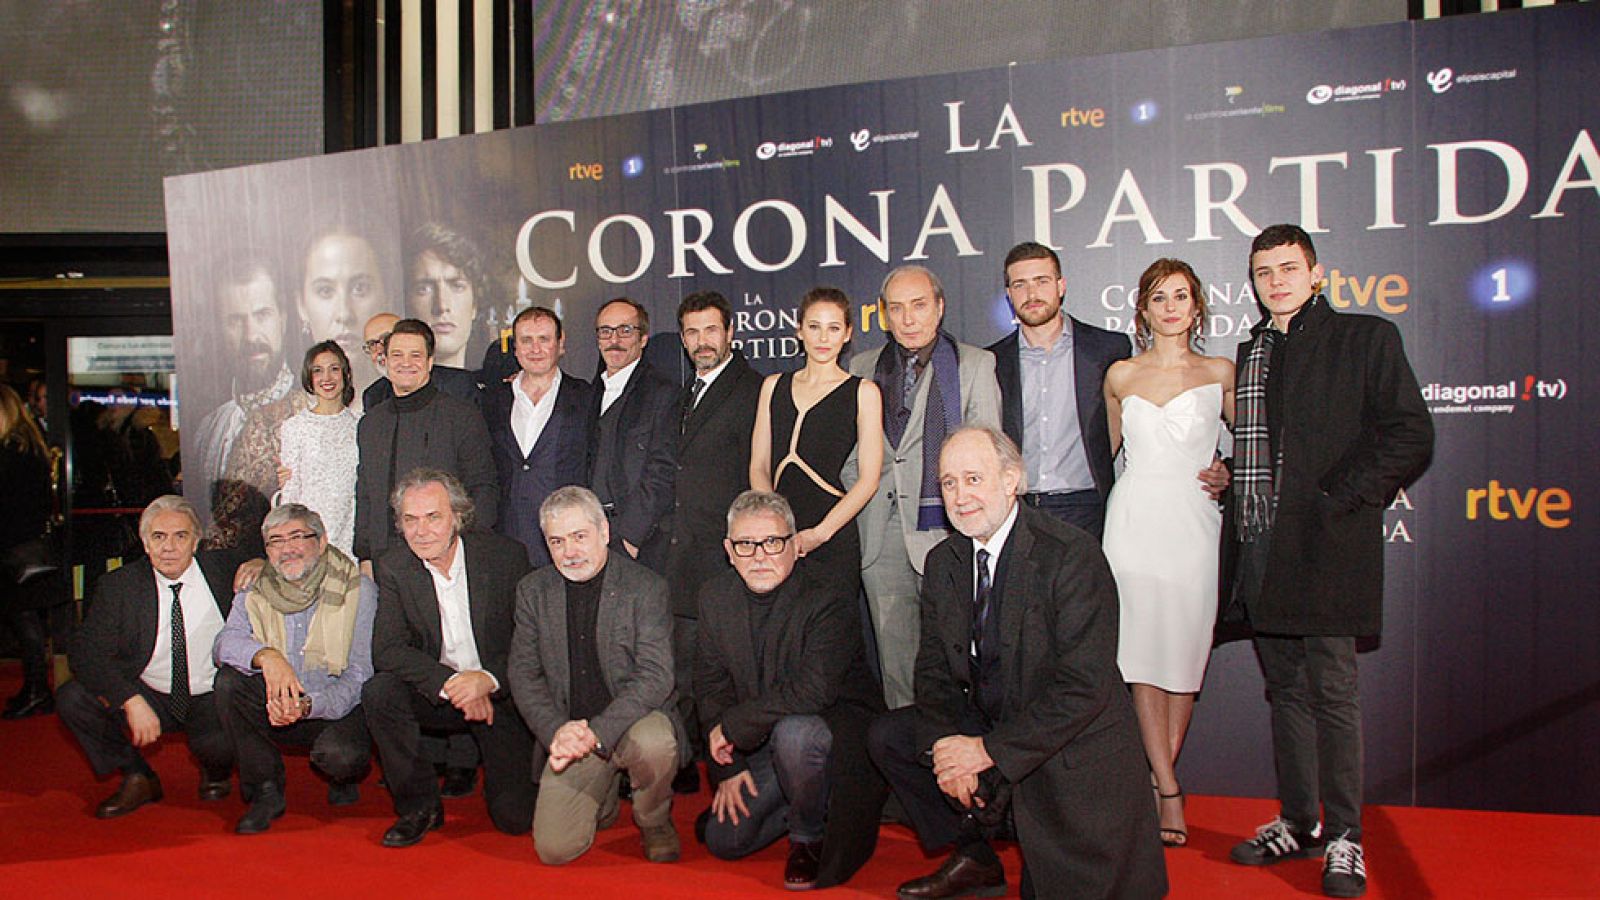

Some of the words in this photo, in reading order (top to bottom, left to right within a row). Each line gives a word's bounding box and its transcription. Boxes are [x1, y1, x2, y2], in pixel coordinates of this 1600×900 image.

[1333, 82, 1381, 96] diagonal
[943, 101, 1035, 154] LA
[1060, 107, 1105, 128] rtve
[569, 162, 604, 180] rtve
[515, 183, 984, 290] CORONA
[1022, 128, 1600, 251] PARTIDA
[1491, 269, 1510, 301] 1
[744, 292, 763, 306] LA
[735, 308, 799, 332] RON
[1421, 381, 1516, 403] diagonal
[1473, 404, 1515, 415] company
[1466, 480, 1572, 529] rtve
